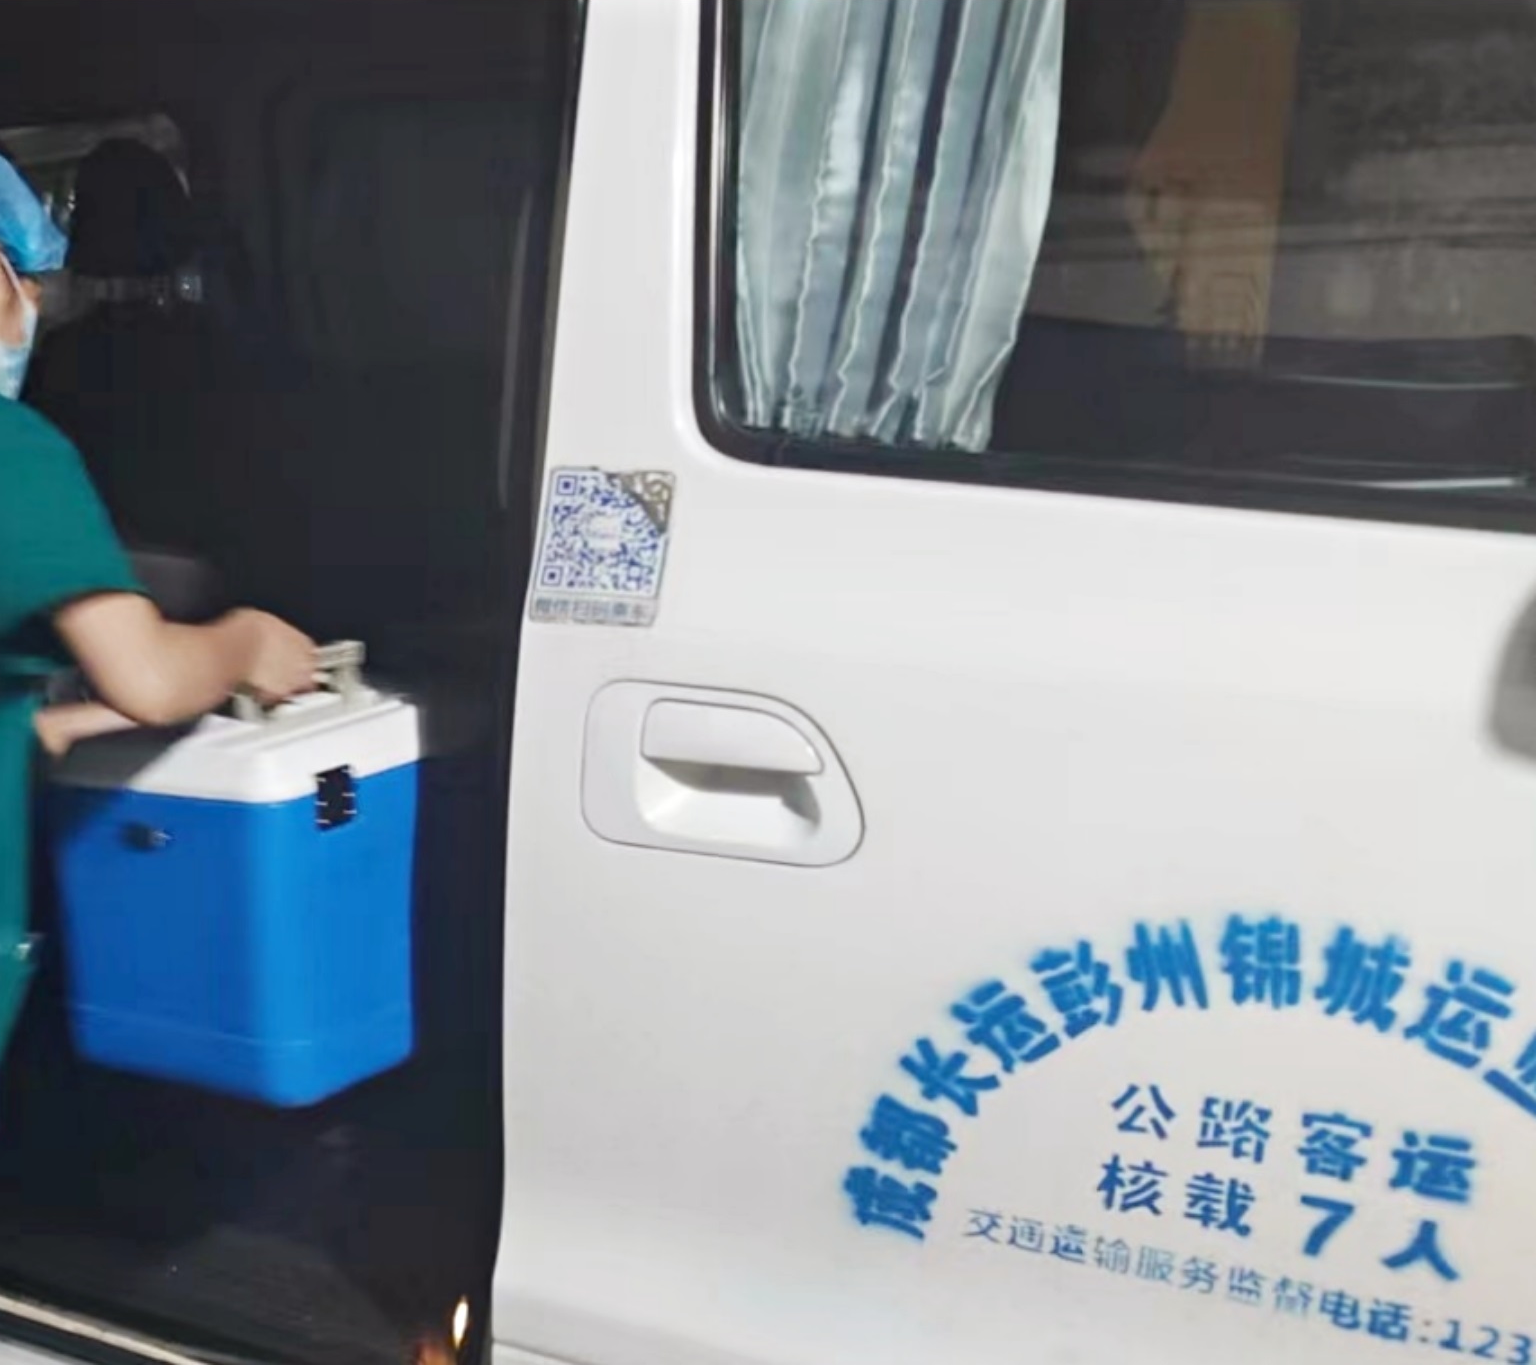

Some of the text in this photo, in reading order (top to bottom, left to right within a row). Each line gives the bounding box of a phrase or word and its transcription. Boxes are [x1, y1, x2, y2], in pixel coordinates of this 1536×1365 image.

[1109, 1082, 1478, 1206] 公路客运
[1095, 1153, 1461, 1283] 核载7人
